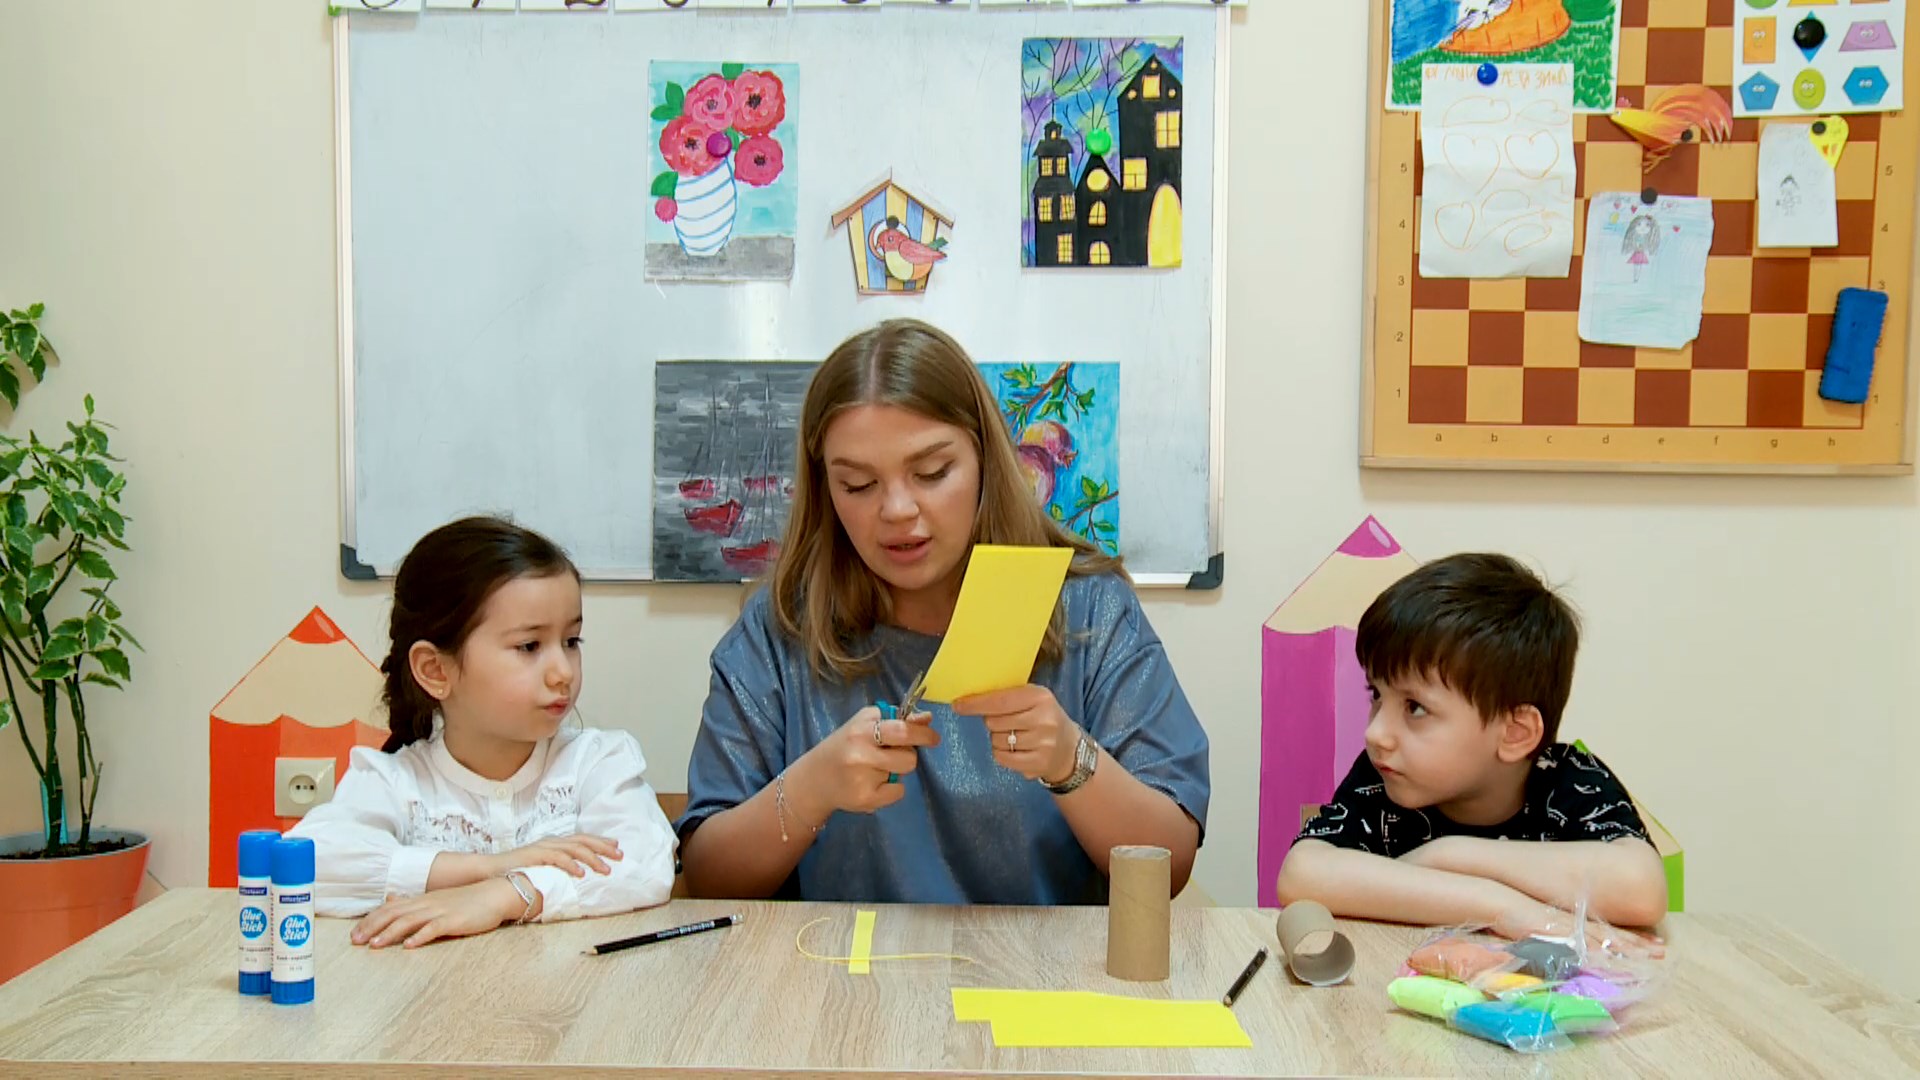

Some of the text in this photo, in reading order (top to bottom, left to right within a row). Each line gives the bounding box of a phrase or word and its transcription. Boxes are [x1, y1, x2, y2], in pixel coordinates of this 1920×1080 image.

[242, 909, 262, 921] Glue
[241, 920, 264, 932] Stick
[285, 916, 307, 929] Glue
[282, 927, 308, 941] Stick
